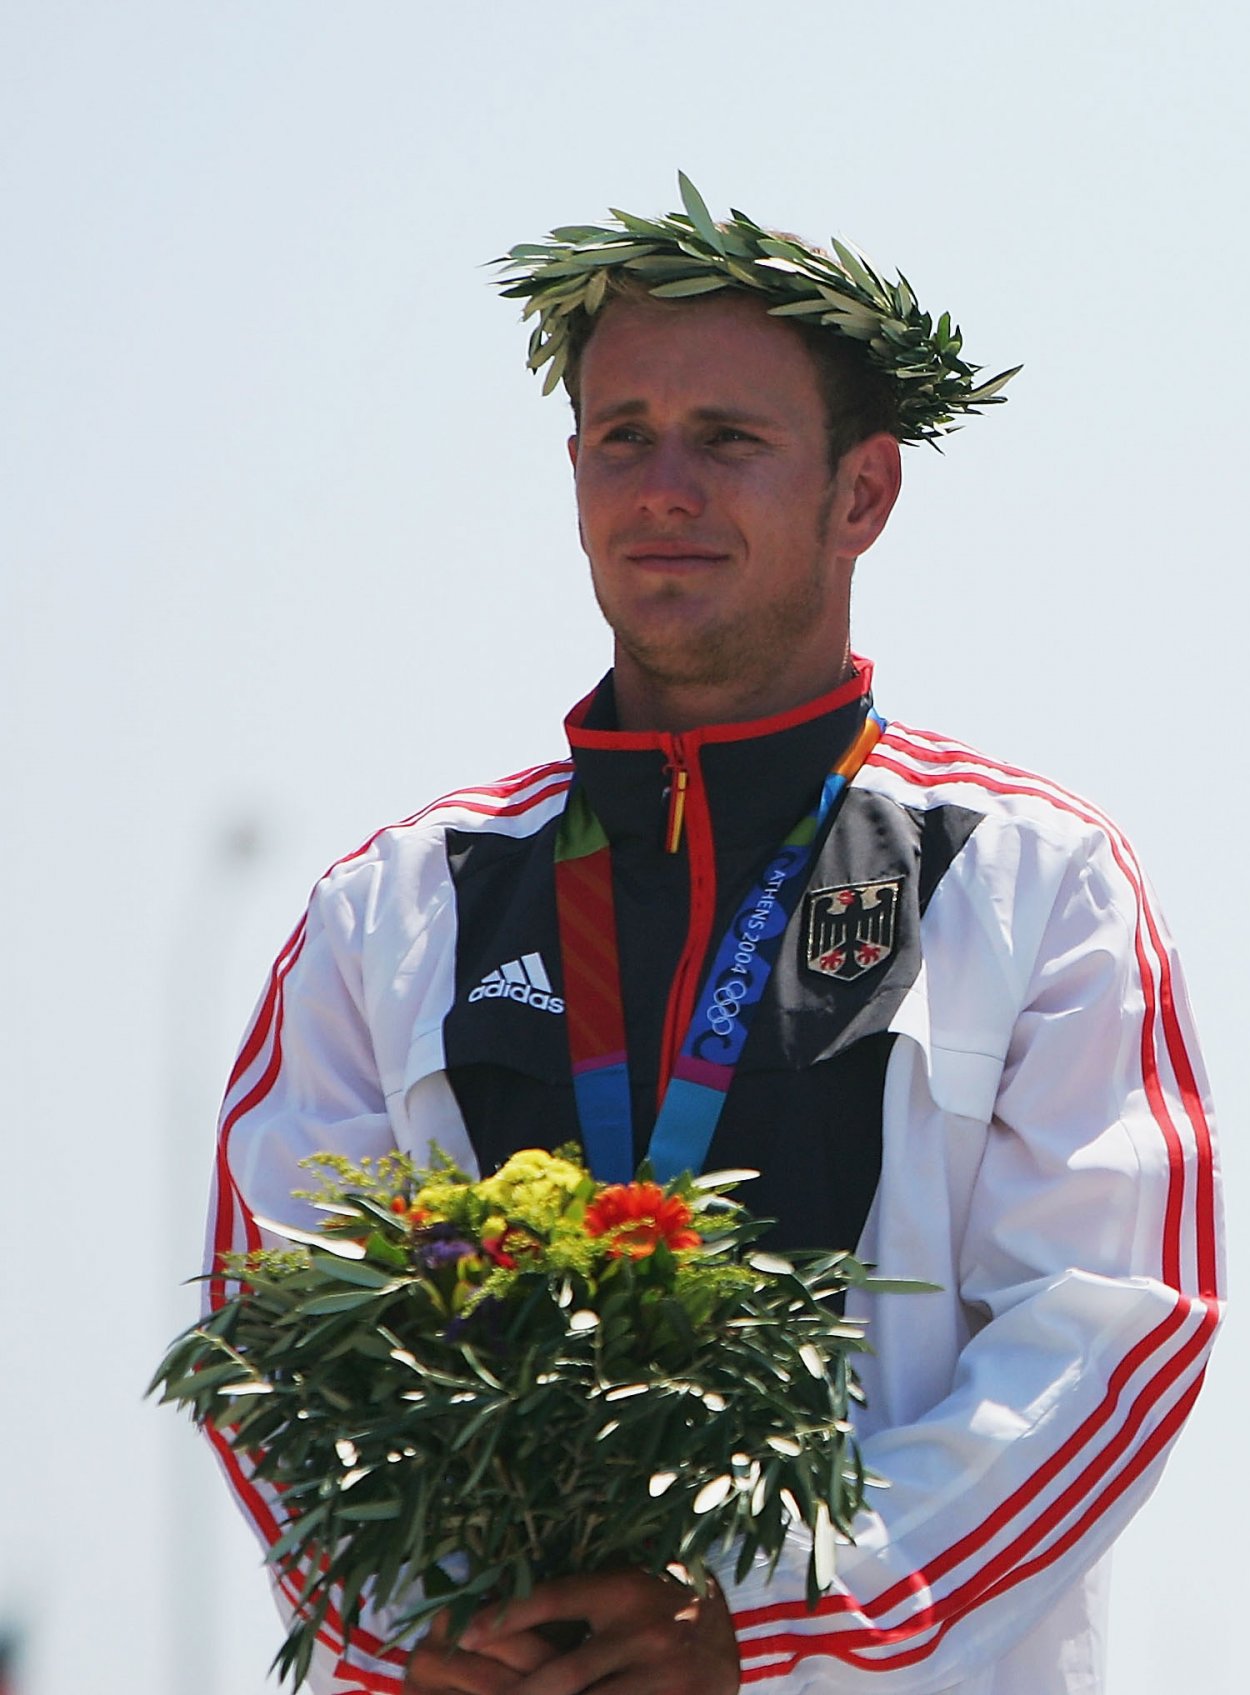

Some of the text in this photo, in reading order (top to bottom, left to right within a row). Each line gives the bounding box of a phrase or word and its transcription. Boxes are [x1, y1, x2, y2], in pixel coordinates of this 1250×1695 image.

[730, 869, 787, 975] ATHENS 2004
[468, 979, 566, 1014] adidas
